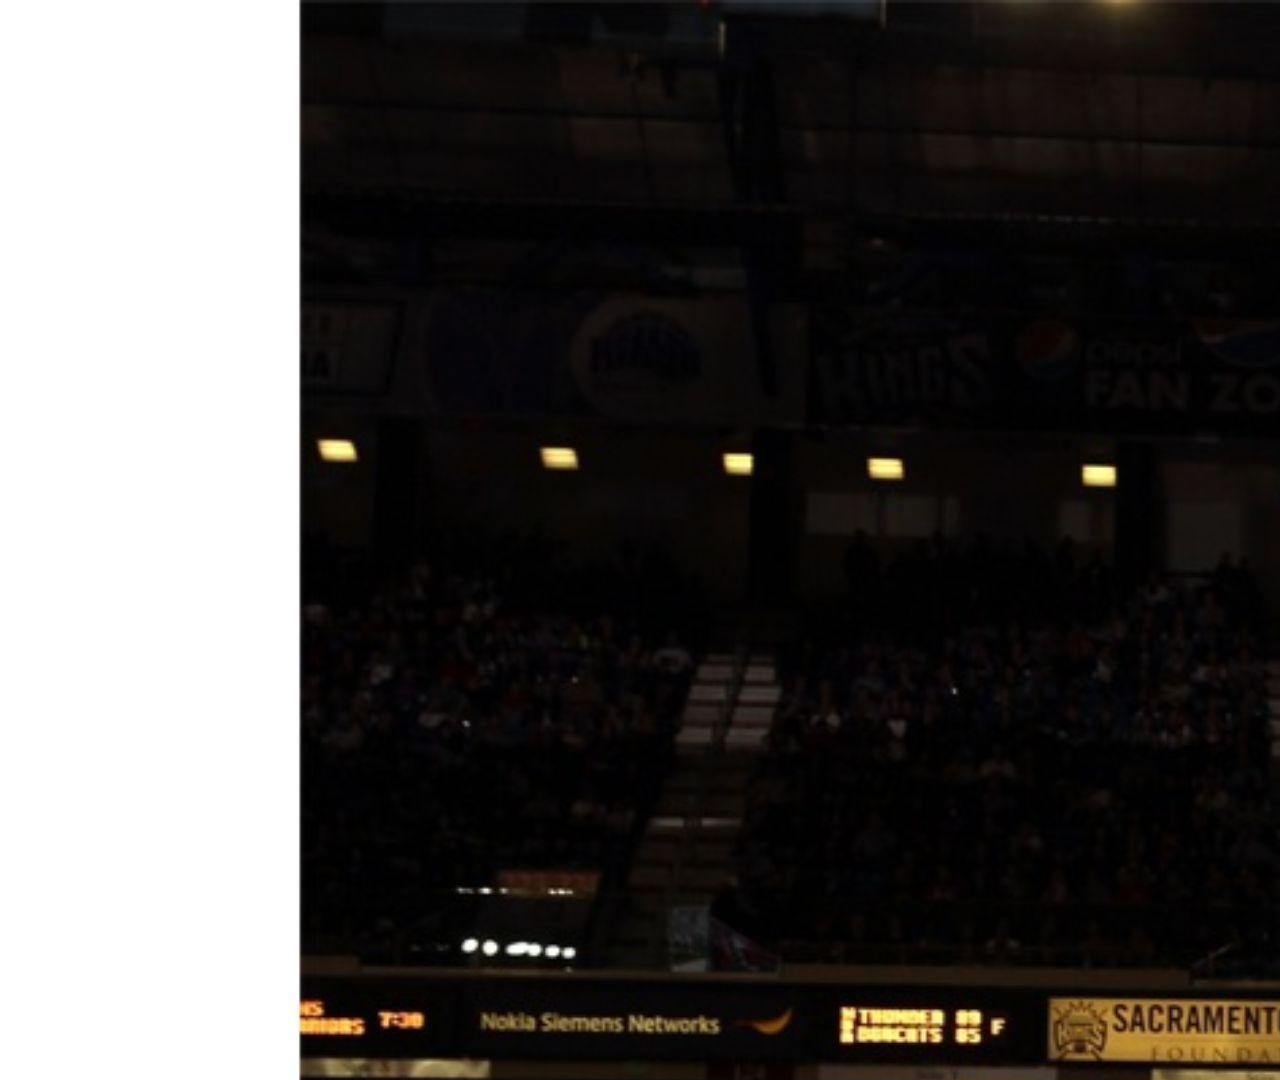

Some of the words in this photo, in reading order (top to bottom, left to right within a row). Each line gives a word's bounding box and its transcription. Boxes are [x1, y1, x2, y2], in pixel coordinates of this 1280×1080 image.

[1085, 368, 1188, 410] FAN
[480, 1012, 536, 1033] Nokia
[541, 1013, 624, 1033] Siemens
[628, 1014, 720, 1035] Networks
[990, 1017, 1005, 1036] F
